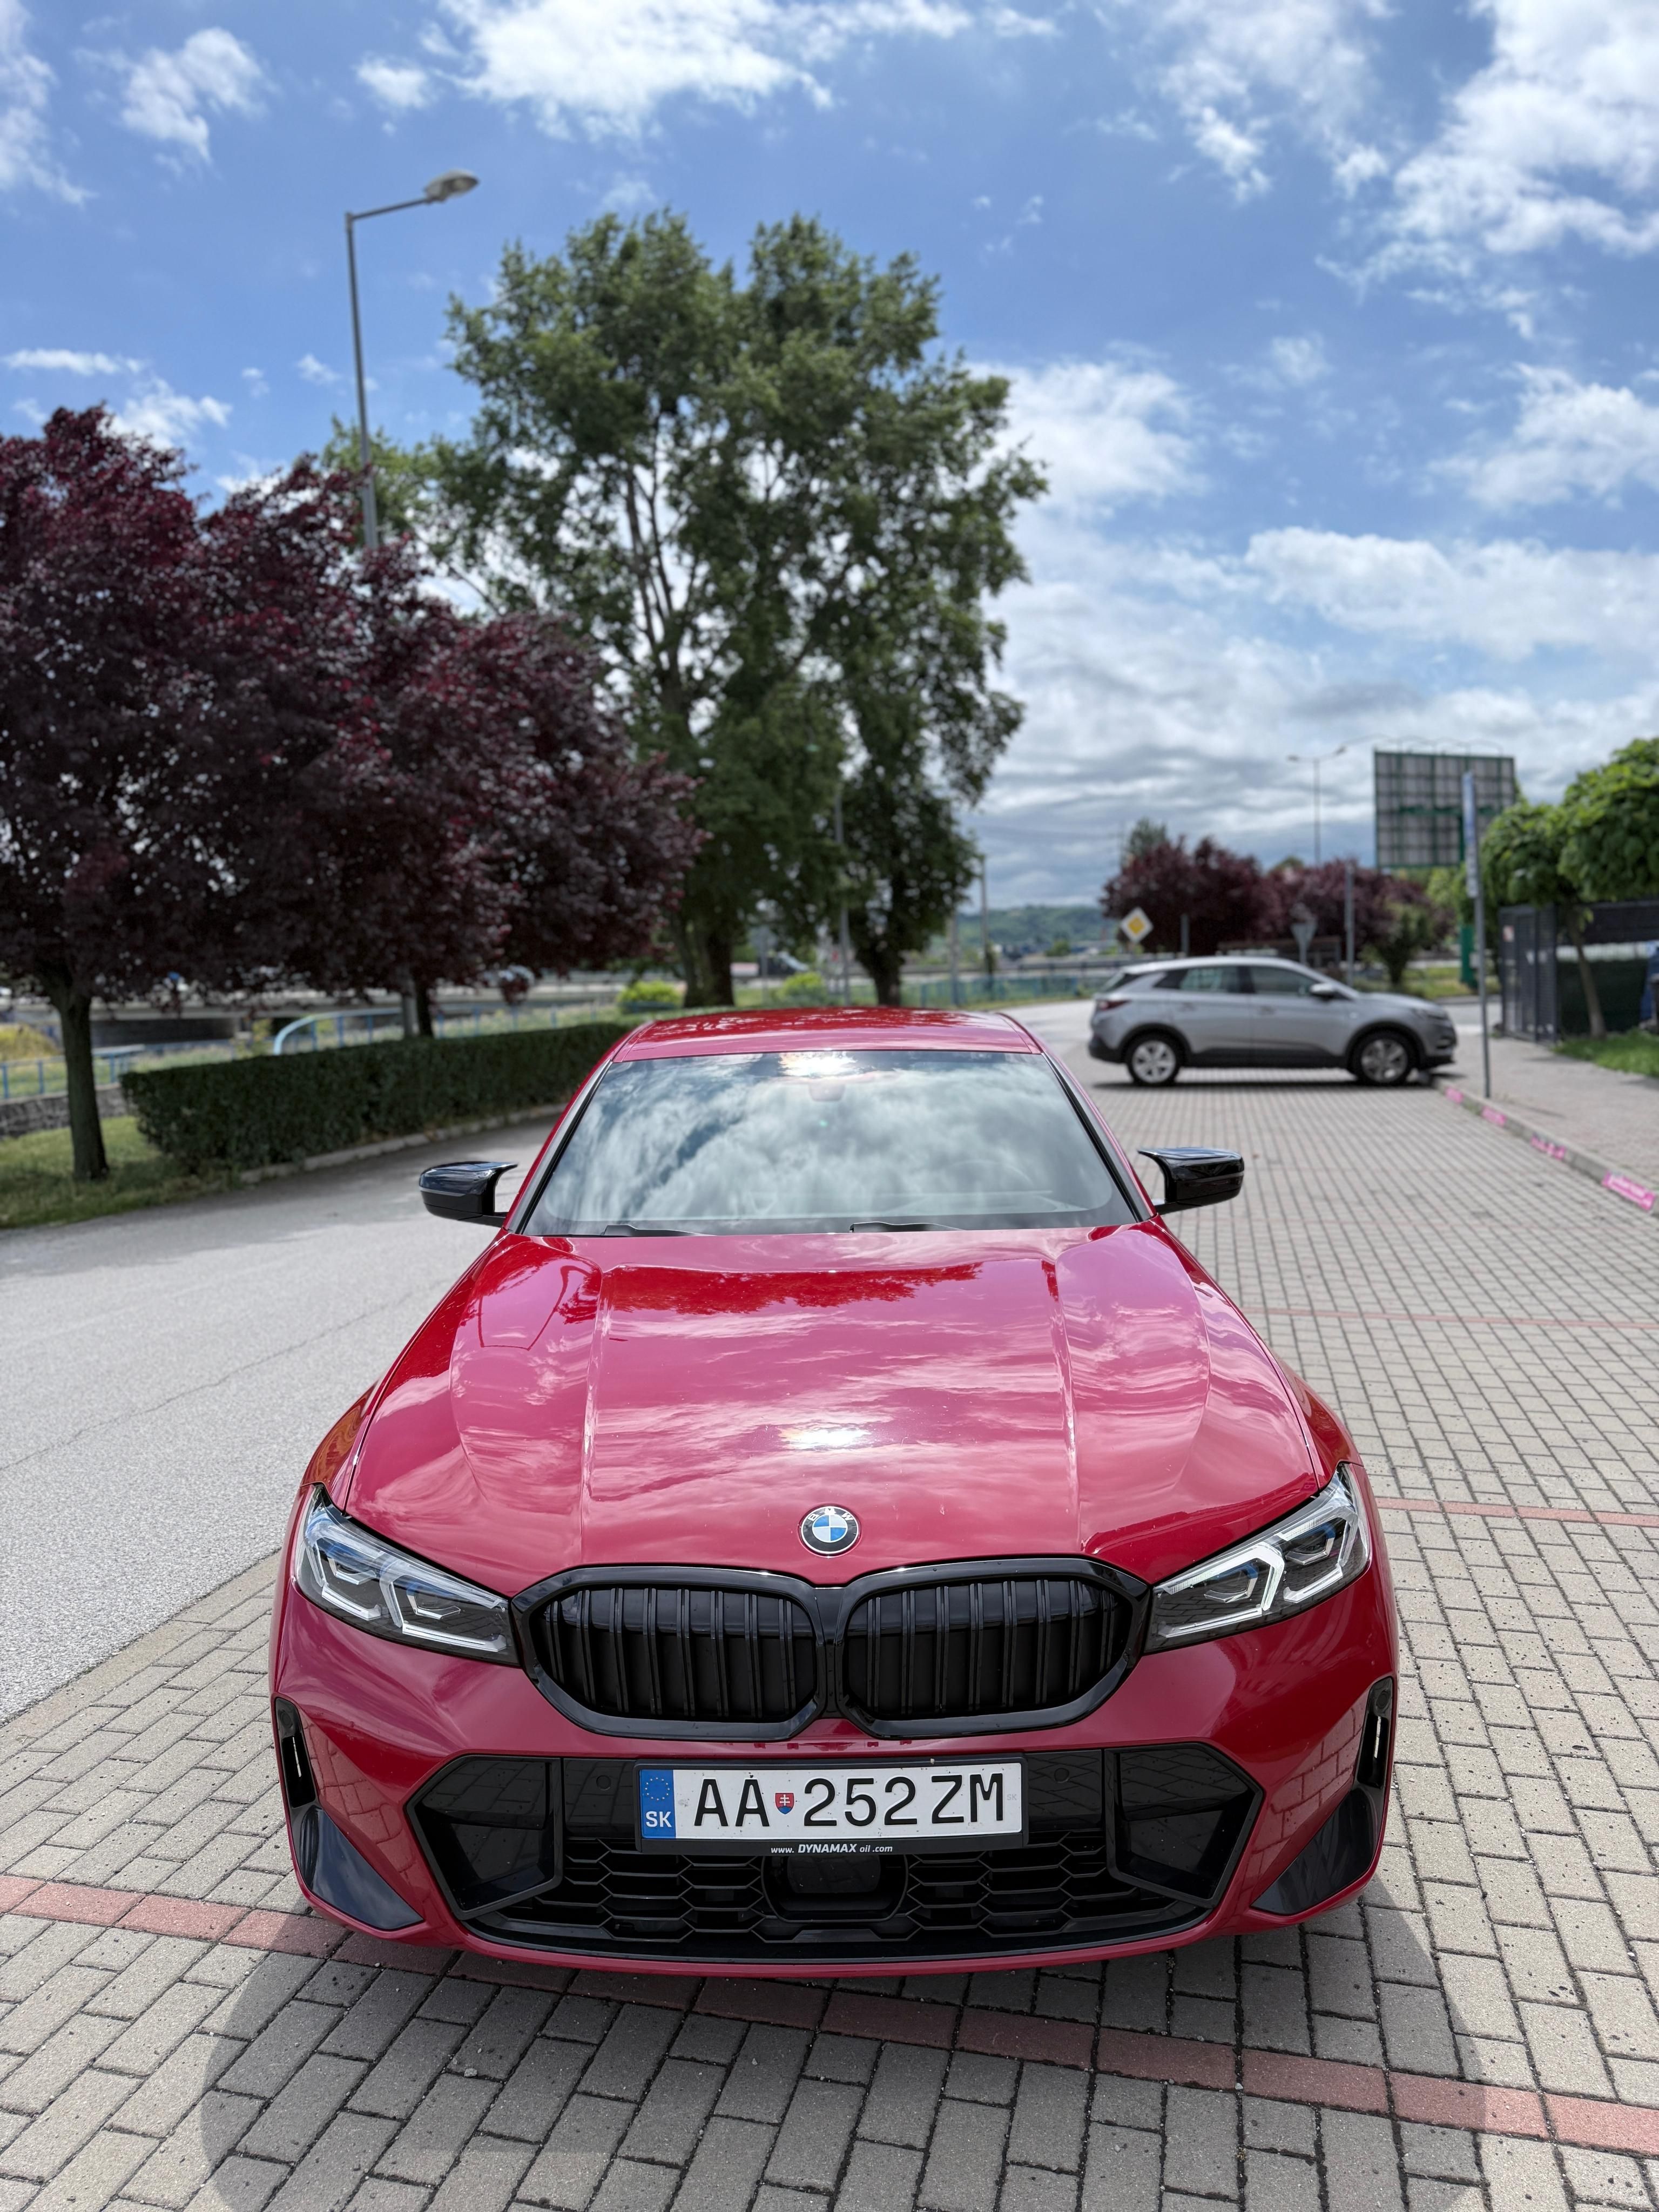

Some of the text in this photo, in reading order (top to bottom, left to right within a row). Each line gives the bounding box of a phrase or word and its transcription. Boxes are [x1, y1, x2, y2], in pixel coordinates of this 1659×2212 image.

[807, 1508, 854, 1521] BMW
[694, 1779, 770, 1826] AA
[646, 1811, 672, 1827] SK
[798, 1844, 857, 1853] DYNAMAX
[859, 1845, 870, 1853] oil
